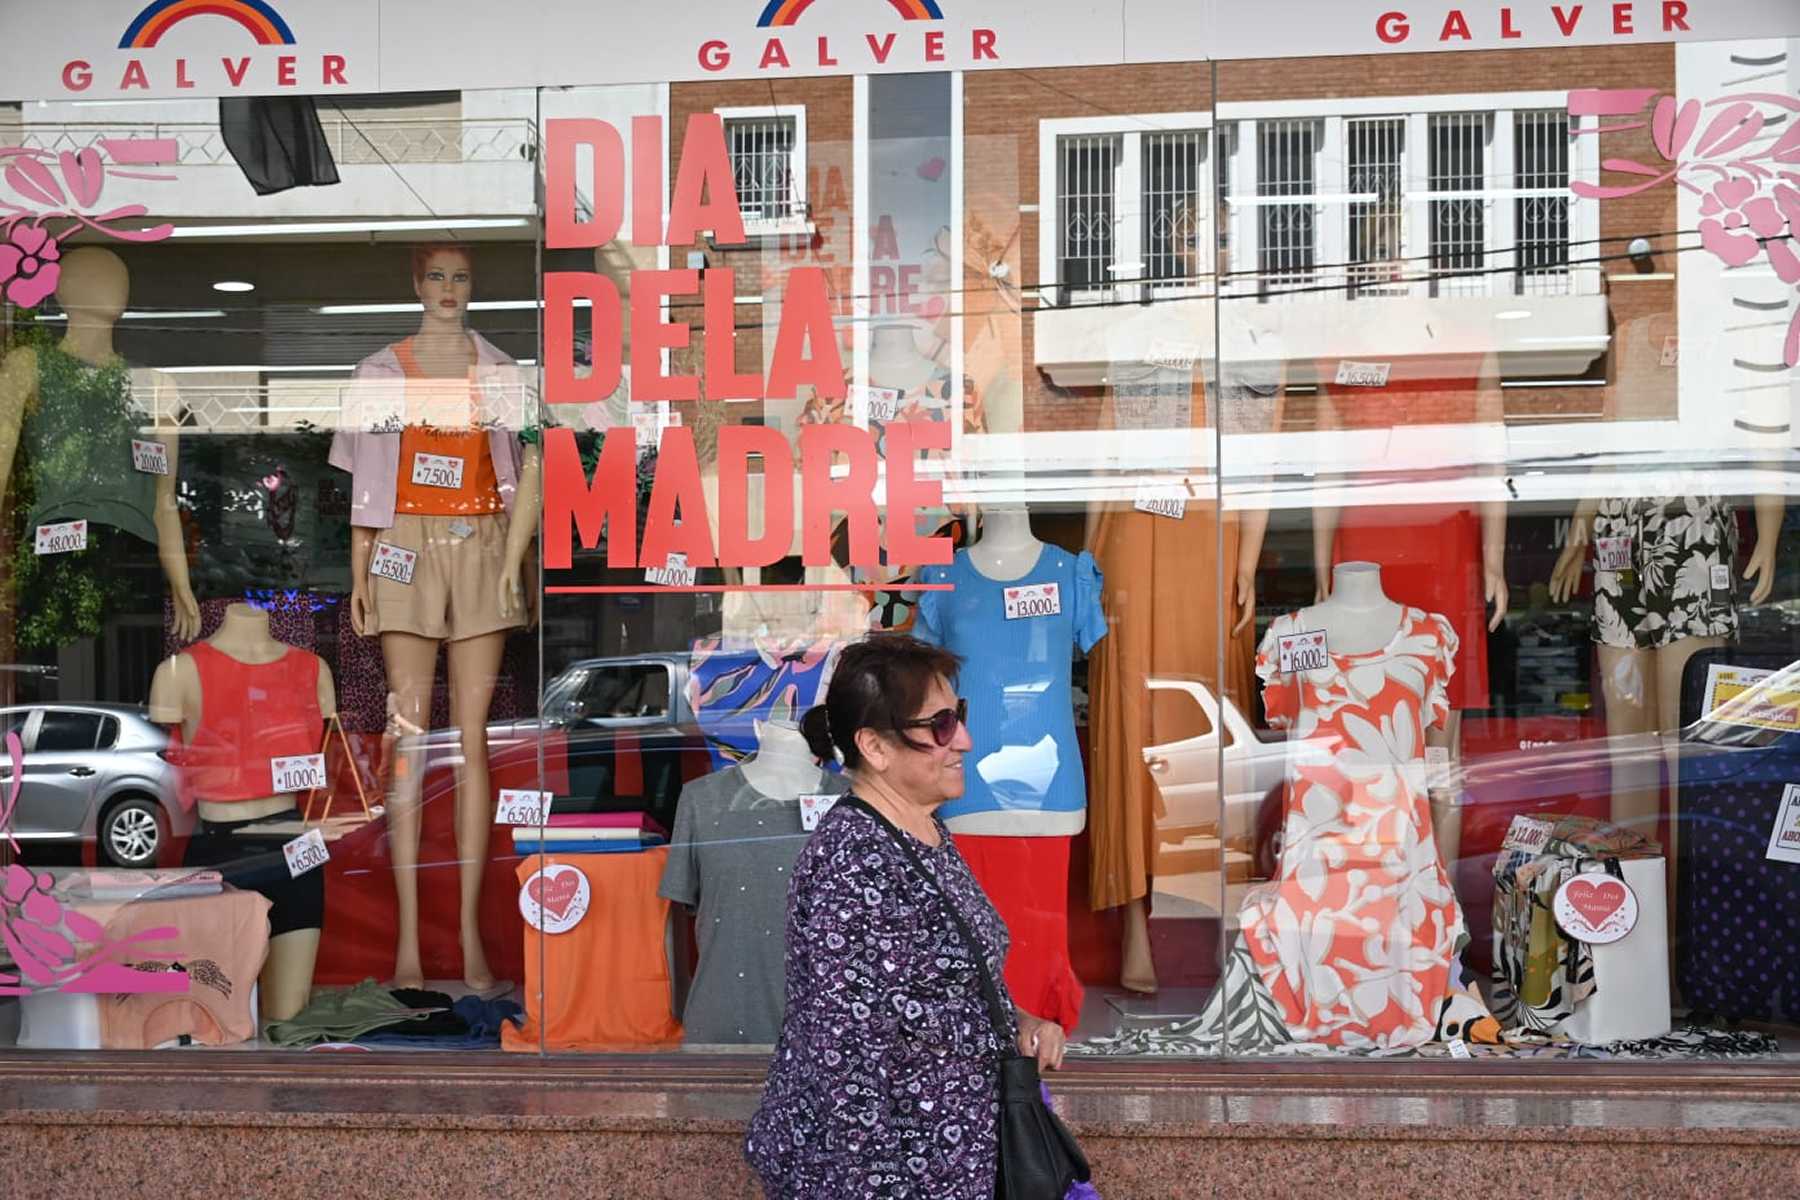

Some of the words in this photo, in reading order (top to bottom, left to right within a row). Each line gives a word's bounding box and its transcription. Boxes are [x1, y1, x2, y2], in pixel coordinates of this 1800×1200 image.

[1375, 0, 1690, 44] GALVER
[698, 28, 998, 71] GALVER
[61, 55, 349, 91] GALVER
[545, 113, 746, 249] DIA
[544, 423, 953, 569] MADRE
